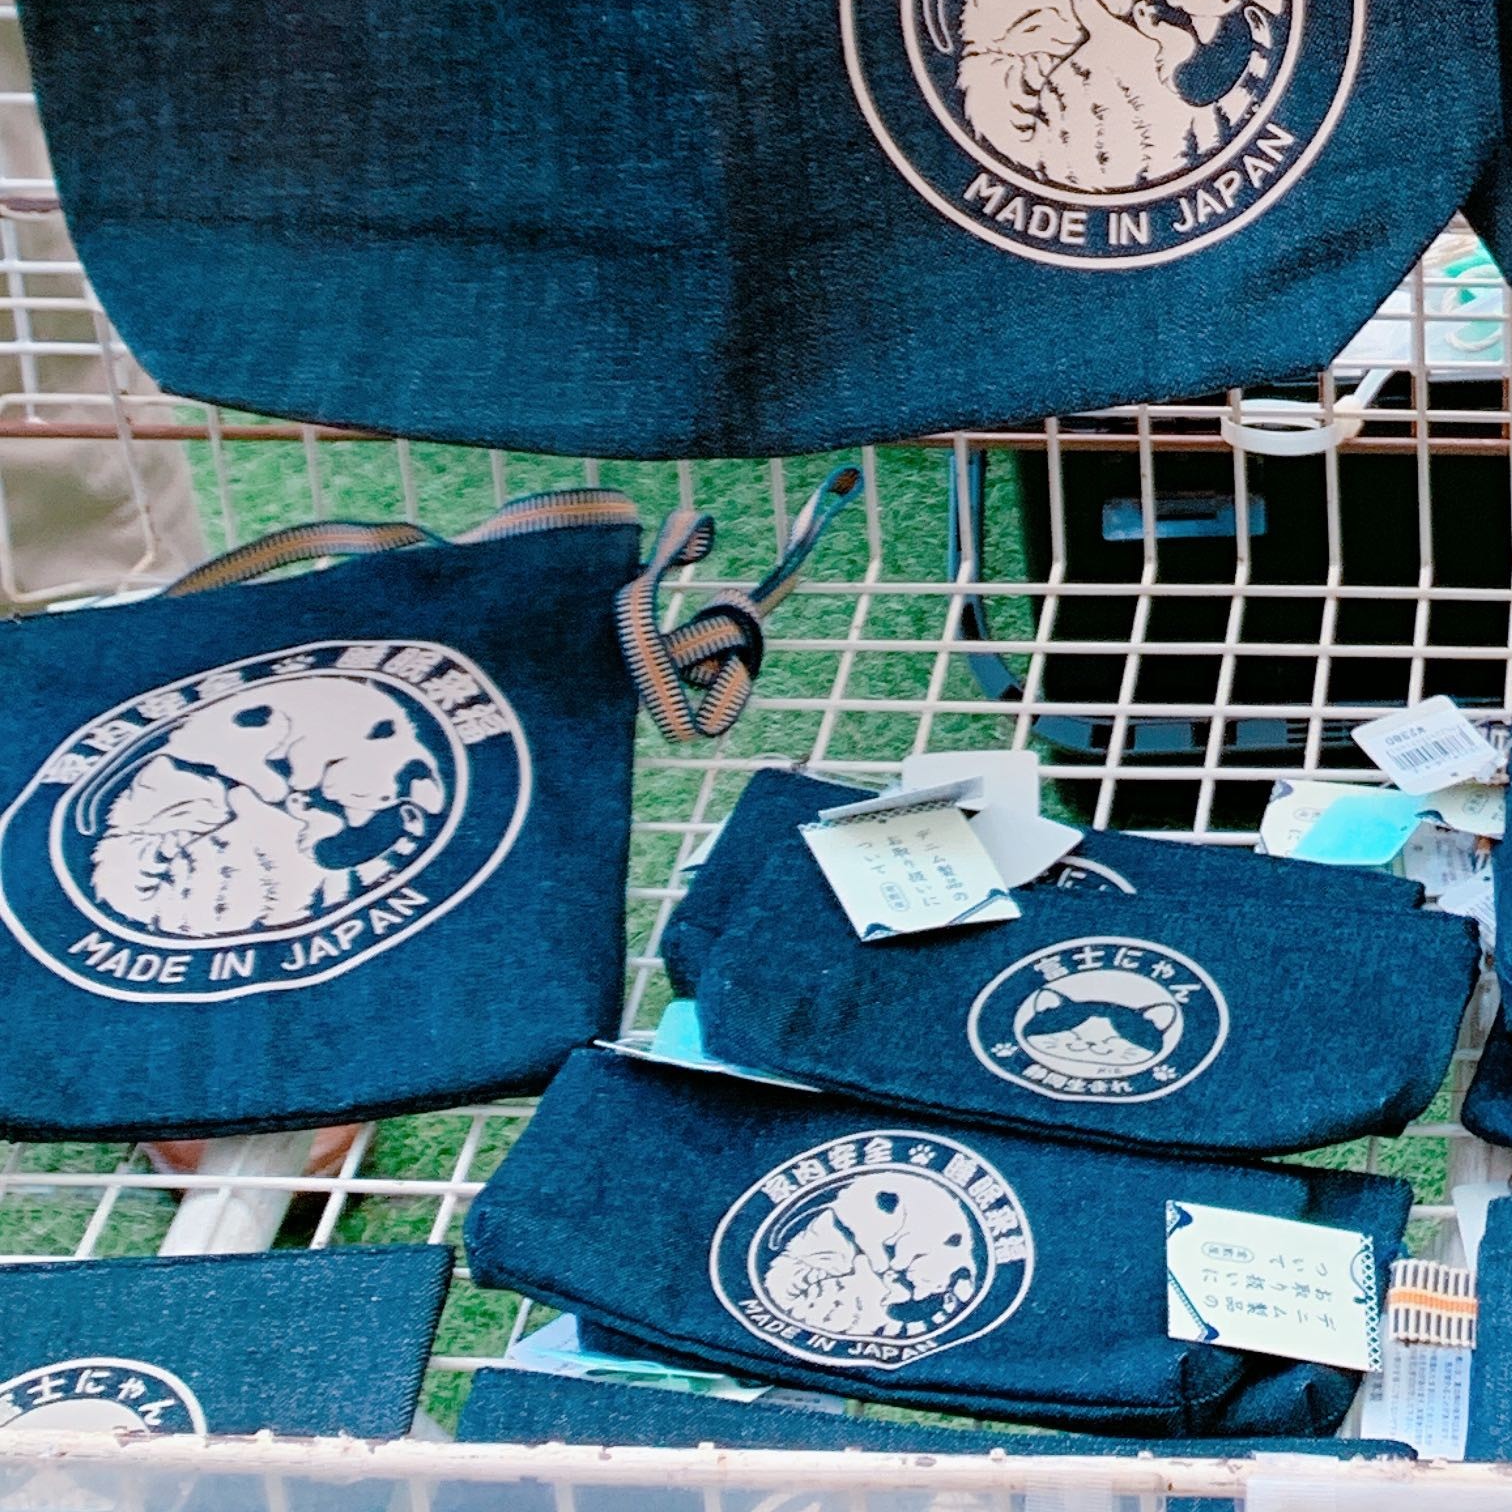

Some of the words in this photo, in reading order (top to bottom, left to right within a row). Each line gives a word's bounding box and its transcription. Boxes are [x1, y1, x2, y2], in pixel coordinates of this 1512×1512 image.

[963, 172, 1088, 246] MADE
[1107, 210, 1152, 246] IN
[1172, 121, 1296, 233] JAPAN
[69, 932, 192, 983] MADE
[208, 949, 256, 981] IN
[281, 888, 430, 972] JAPAN
[1033, 945, 1201, 1004] 富士にゃん
[738, 1297, 801, 1340] MADE
[807, 1334, 836, 1352] IN
[848, 1338, 938, 1362] JAPAN
